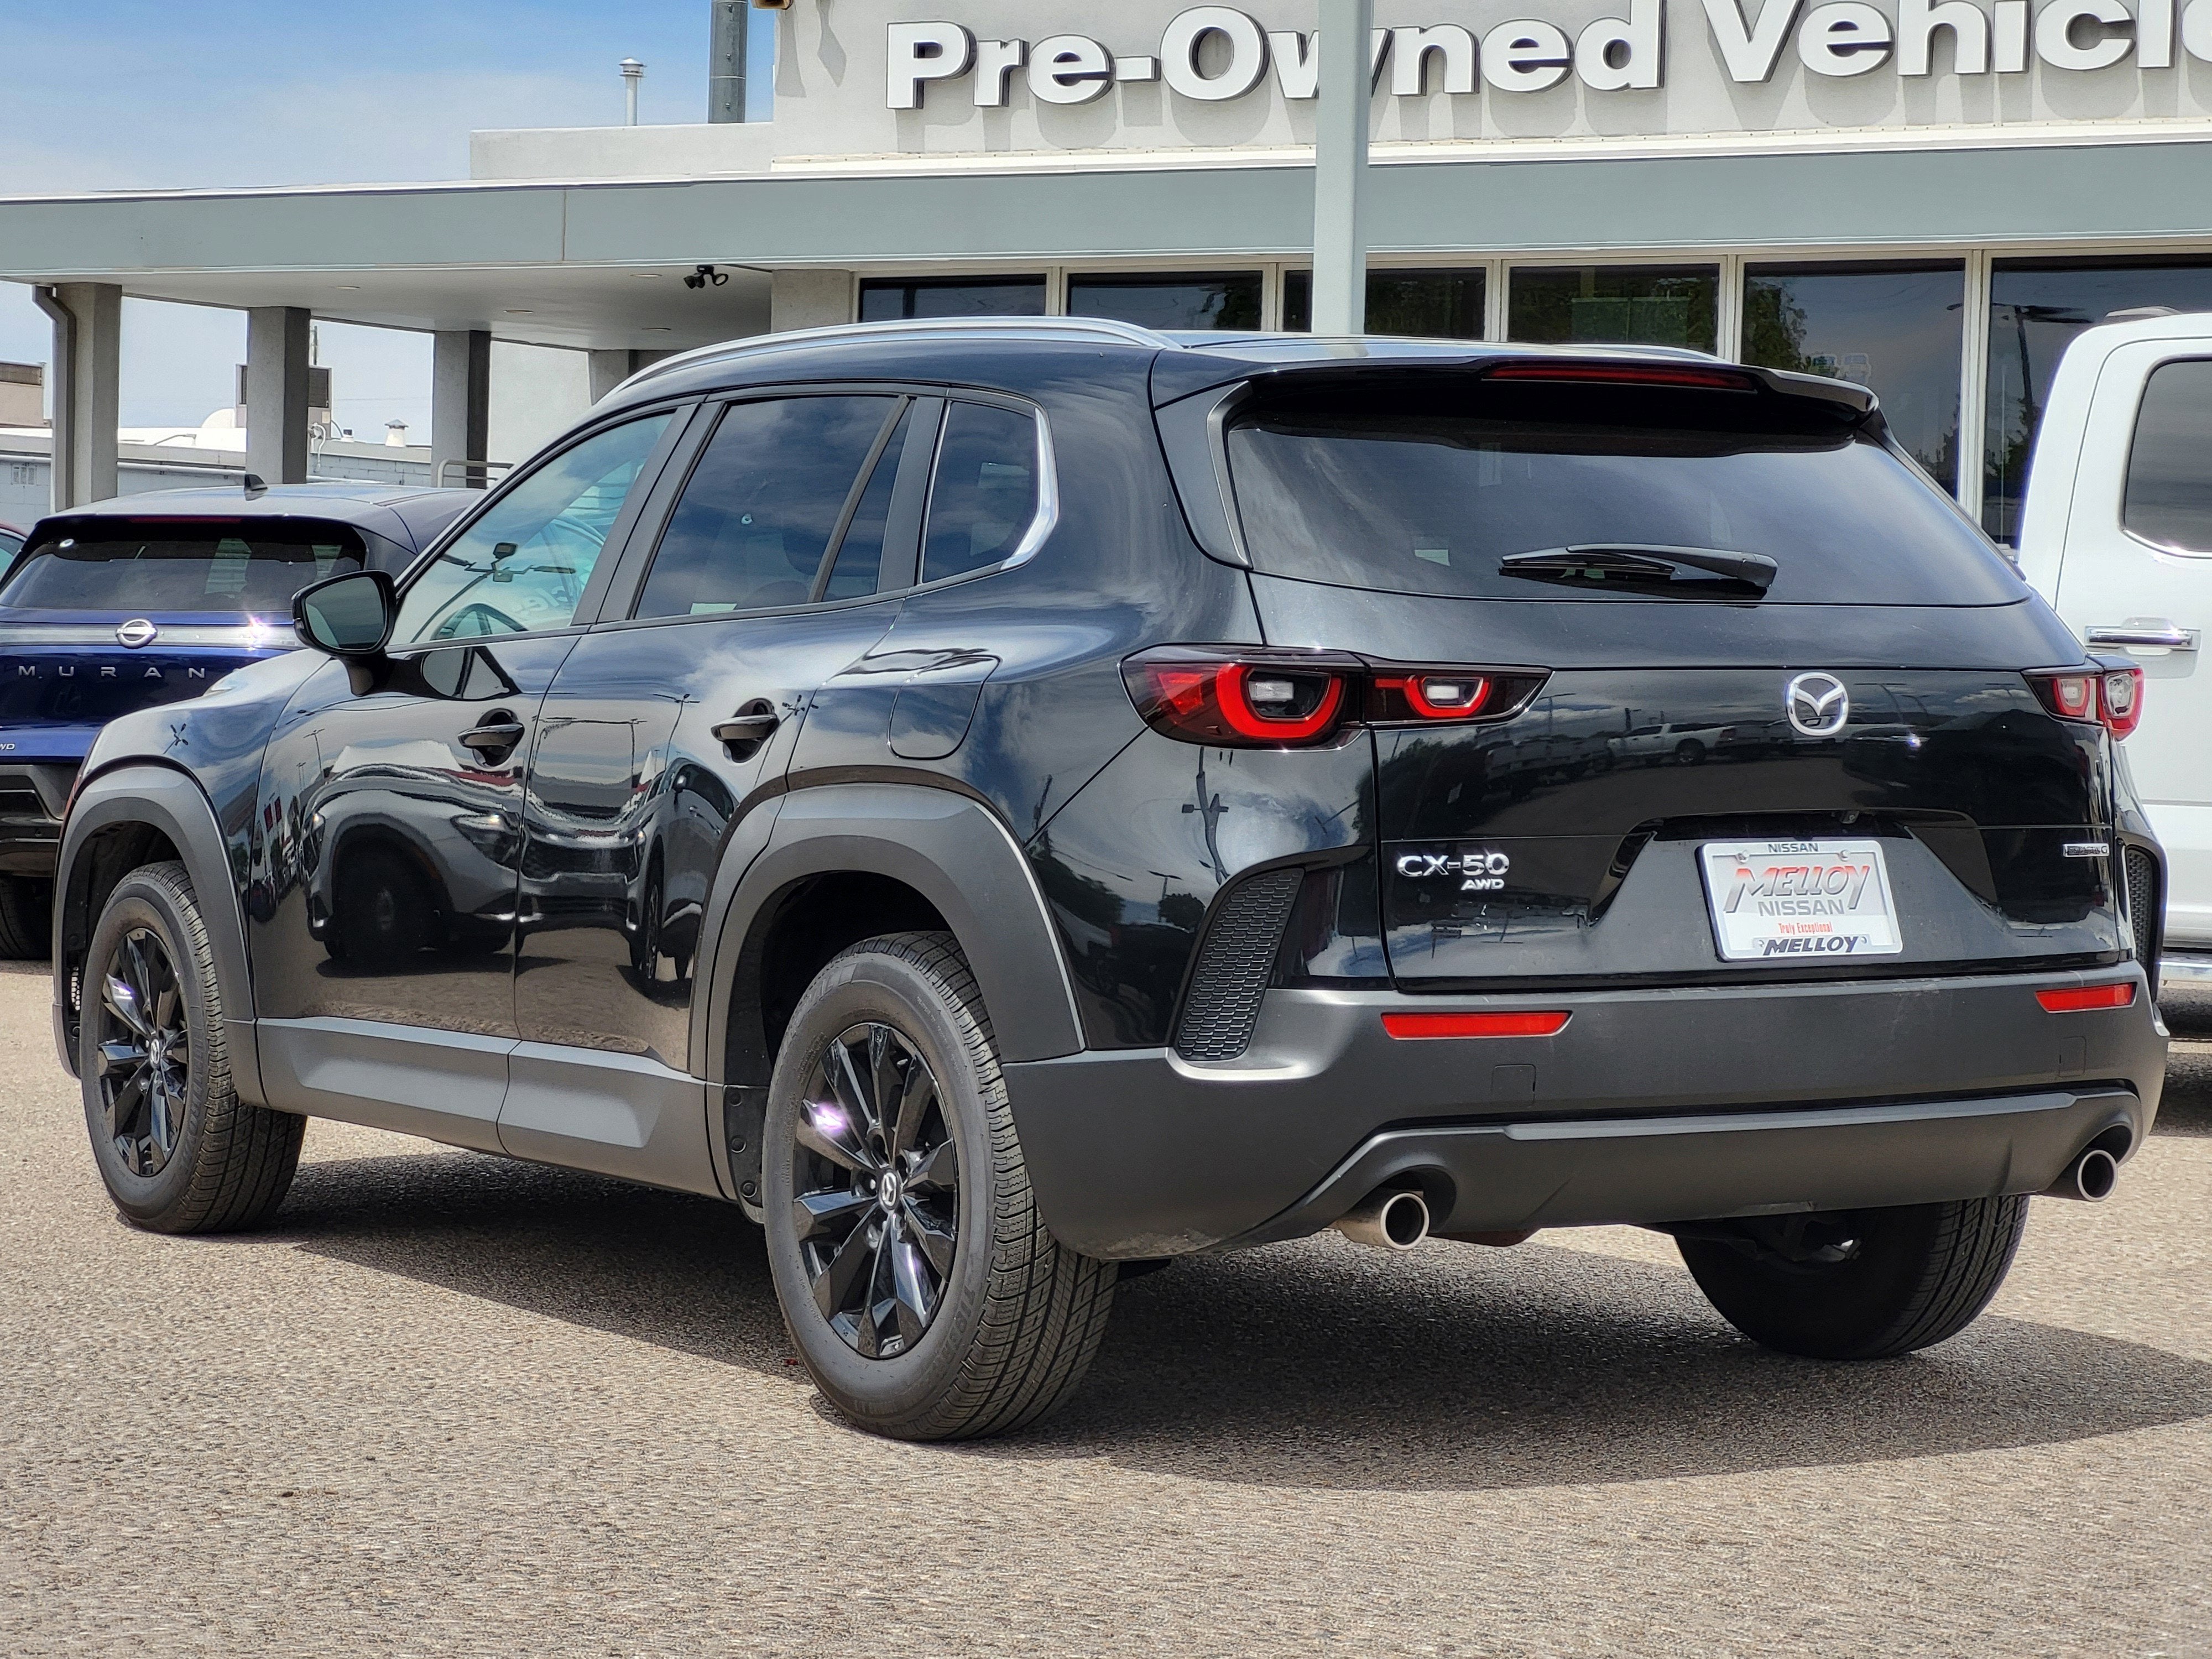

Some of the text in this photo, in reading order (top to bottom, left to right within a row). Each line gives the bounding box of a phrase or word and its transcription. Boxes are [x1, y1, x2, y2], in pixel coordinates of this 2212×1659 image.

[885, 0, 1665, 109] Pre-Owned
[18, 666, 240, 678] MURAN
[1768, 843, 1819, 853] NISSAN
[1397, 853, 1510, 877] CX-50
[1460, 879, 1505, 890] AWD
[1724, 865, 1870, 913] MELLOY
[1757, 899, 1845, 917] NISSAN
[1778, 921, 1833, 935] Truly Exceptional
[1763, 936, 1859, 956] MELLOY
